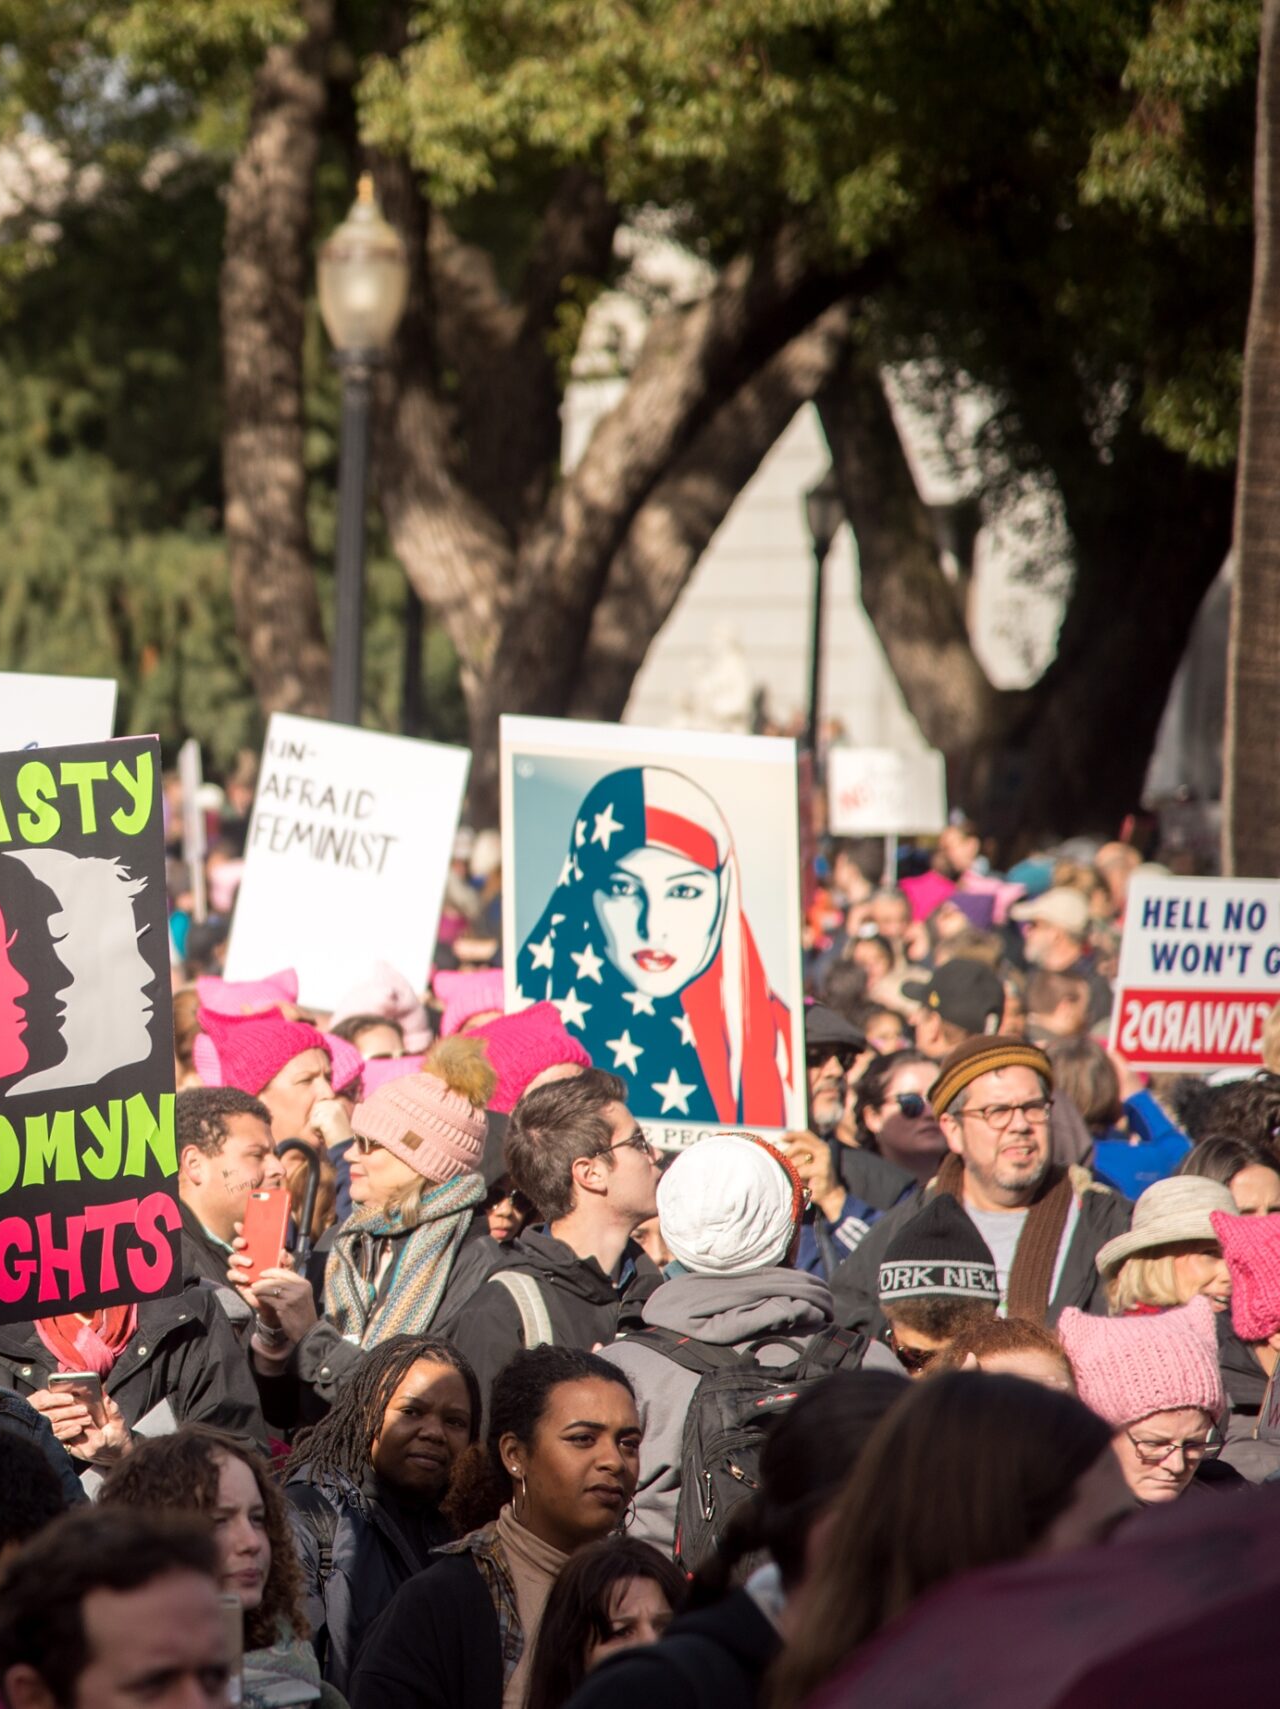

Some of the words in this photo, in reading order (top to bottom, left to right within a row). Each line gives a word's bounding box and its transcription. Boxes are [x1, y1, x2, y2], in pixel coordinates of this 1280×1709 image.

[261, 773, 376, 821] AFRAID
[251, 812, 400, 875] FEMINIST
[1141, 898, 1210, 930] HELL
[1223, 900, 1268, 932] NO
[1150, 941, 1253, 975] WON'T
[879, 1267, 935, 1291] ORK
[944, 1267, 996, 1291] NEW
